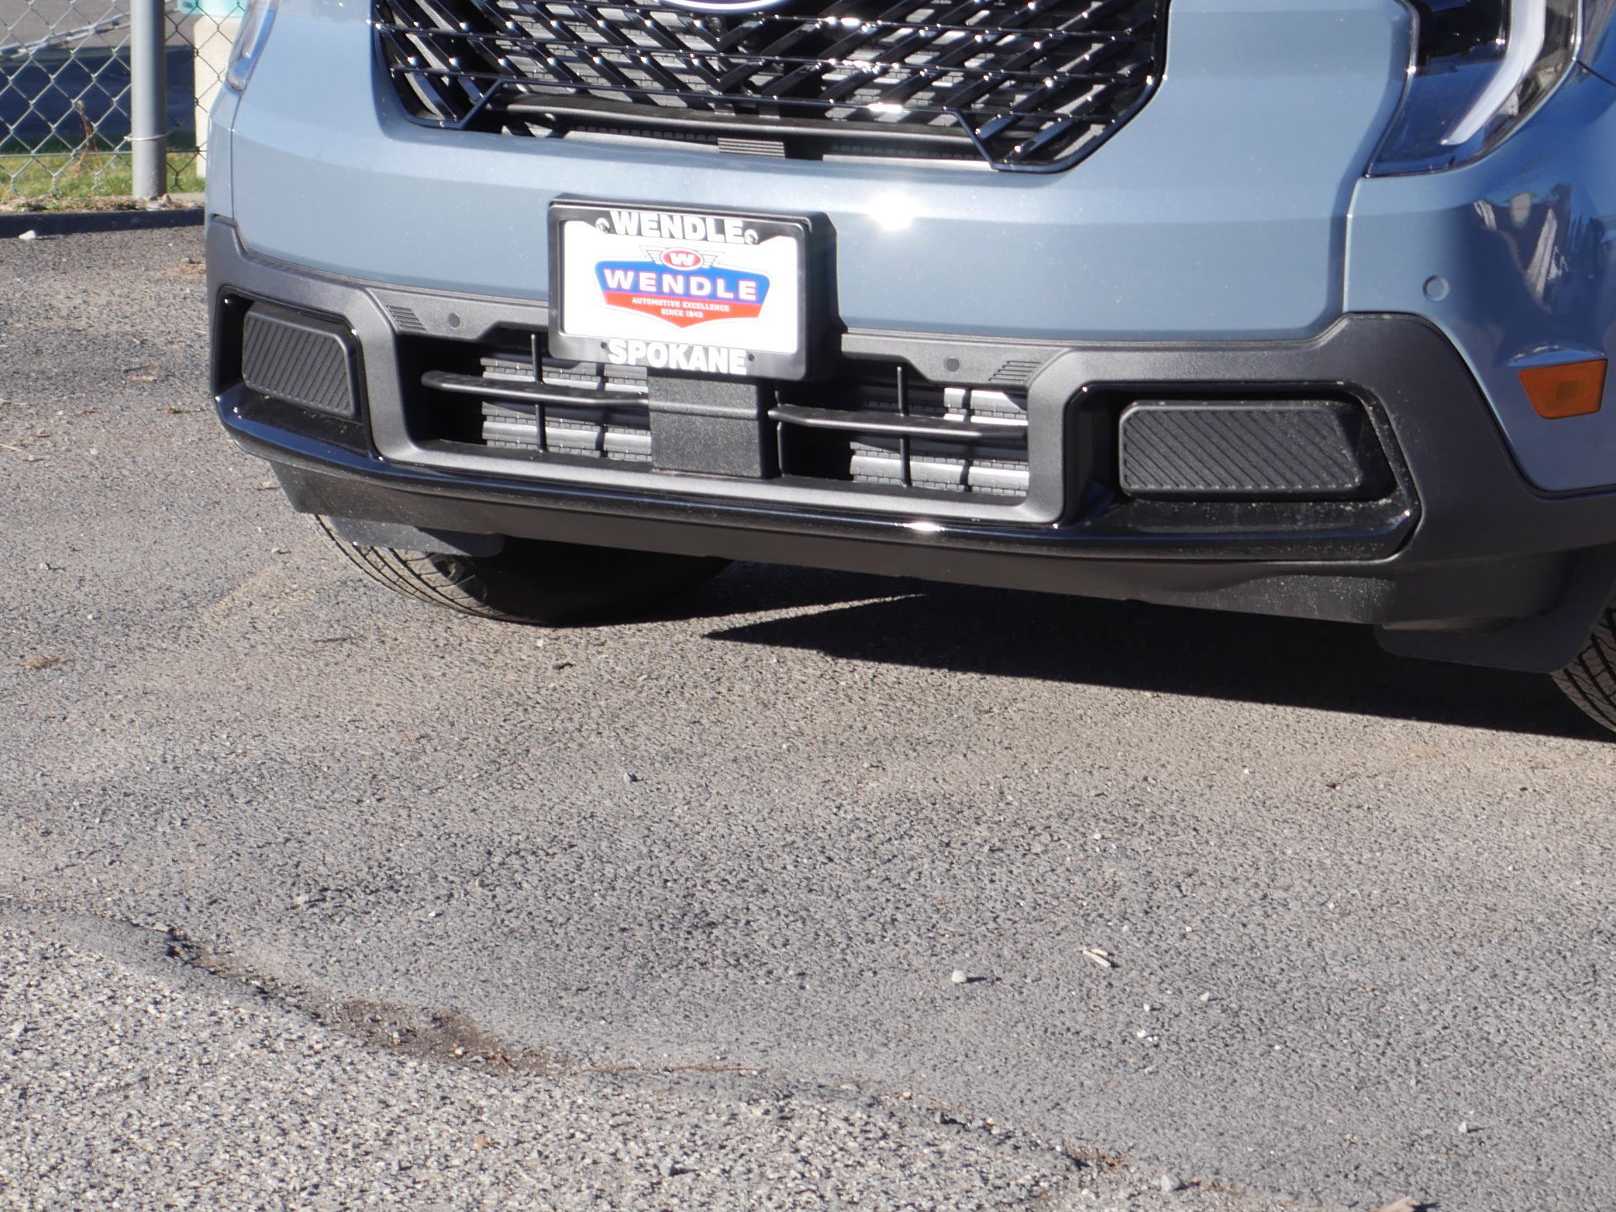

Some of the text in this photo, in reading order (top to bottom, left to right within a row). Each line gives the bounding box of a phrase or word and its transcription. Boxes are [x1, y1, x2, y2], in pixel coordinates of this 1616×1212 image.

[609, 211, 743, 243] WENDLE
[602, 268, 757, 301] WENDLE
[632, 297, 730, 312] AUTOMOTIVE EXCELLENCE
[660, 307, 684, 317] SINCE
[608, 338, 748, 376] SPOKANE
